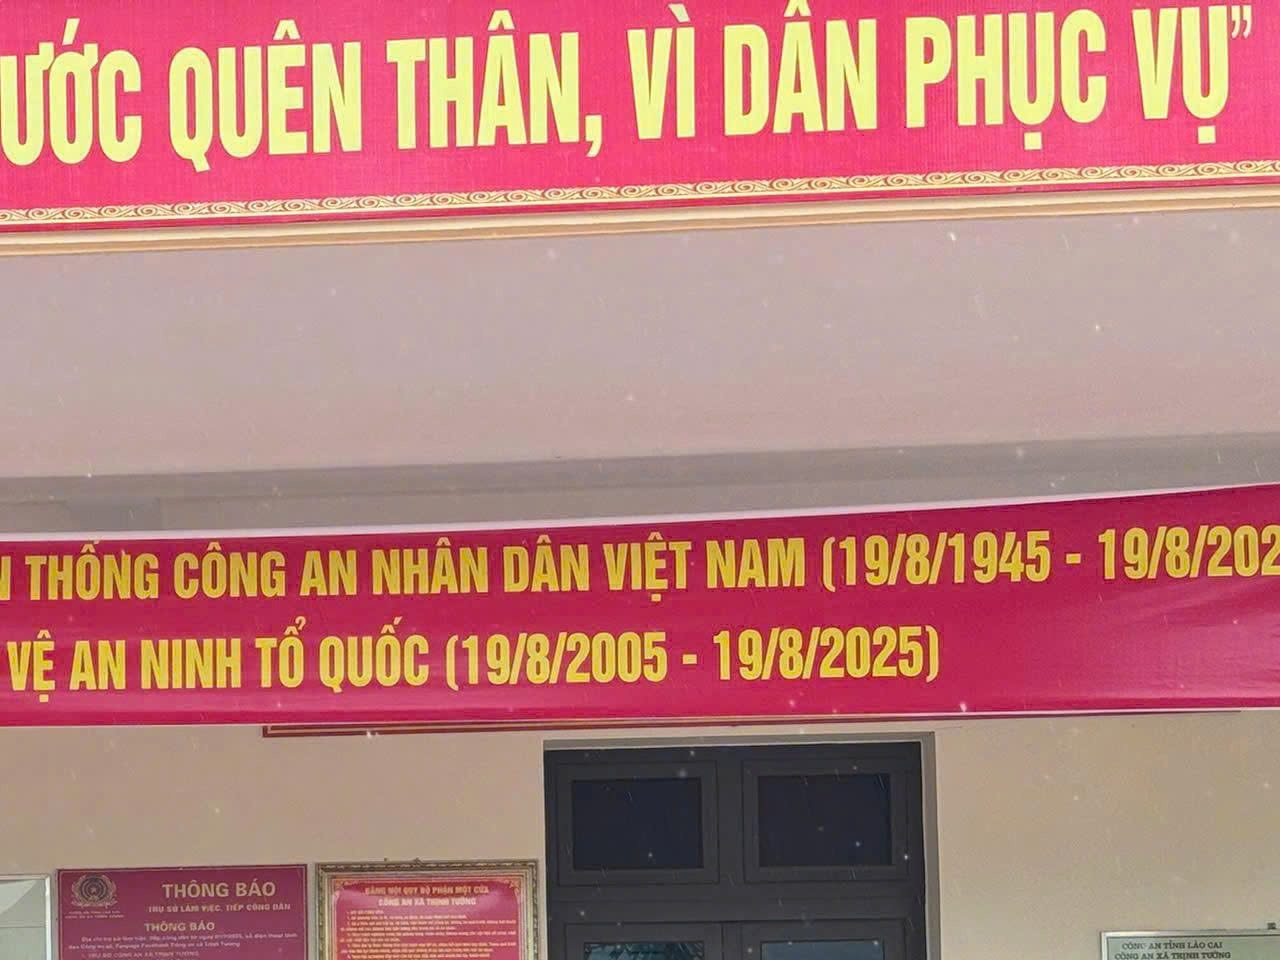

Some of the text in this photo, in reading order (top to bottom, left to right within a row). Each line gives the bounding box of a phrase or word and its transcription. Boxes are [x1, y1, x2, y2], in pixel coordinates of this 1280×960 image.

[169, 20, 362, 172] QUÊN
[387, 10, 602, 157] THÂN,
[628, 4, 695, 139] VÌ
[724, 0, 877, 135] DÂN
[906, 9, 1106, 150] PHỤC
[26, 540, 158, 600] THỐNG
[175, 542, 285, 598] CÔNG
[300, 551, 356, 595] AN
[373, 538, 488, 594] NHÂN
[504, 535, 589, 592] DÂN
[604, 532, 691, 602] VIỆT
[707, 538, 804, 588] NAM
[824, 531, 1050, 592] (19/8/1945
[7, 630, 55, 702] VỆ
[70, 640, 125, 690] AN
[141, 638, 241, 689] NINH
[255, 616, 305, 687] TỔ
[320, 617, 429, 693] QUỐC
[446, 631, 667, 690] (19/8/2005
[714, 626, 938, 682] 19/8/2025)
[162, 878, 276, 898] THÔNG BÁO
[189, 920, 215, 931] BÁO
